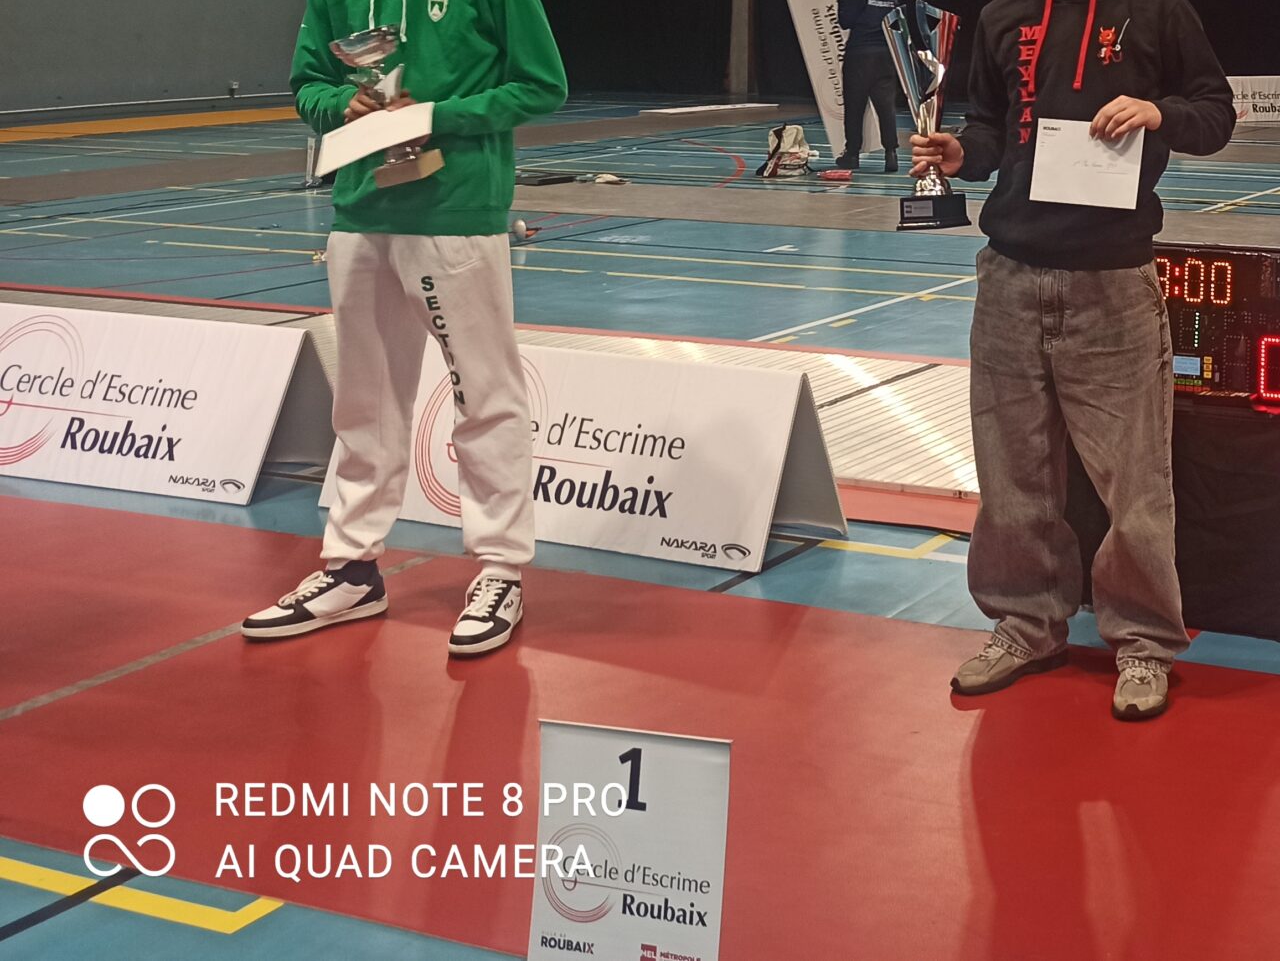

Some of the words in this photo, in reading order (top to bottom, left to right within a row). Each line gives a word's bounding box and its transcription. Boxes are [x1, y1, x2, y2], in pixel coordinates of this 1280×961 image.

[1233, 91, 1249, 100] rcle
[420, 275, 466, 406] SECTION
[0, 364, 75, 397] Cercle
[80, 370, 198, 410] d'Escrime
[60, 416, 182, 462] Roubaix
[547, 412, 686, 460] d'Escrime
[168, 474, 216, 489] NAKARA
[533, 464, 674, 519] Roubaix
[660, 536, 718, 554] NAKARA
[617, 747, 647, 812] 1
[624, 863, 711, 895] d'Escrime
[621, 893, 708, 927] Roubaix
[540, 935, 595, 955] ROUBAIX
